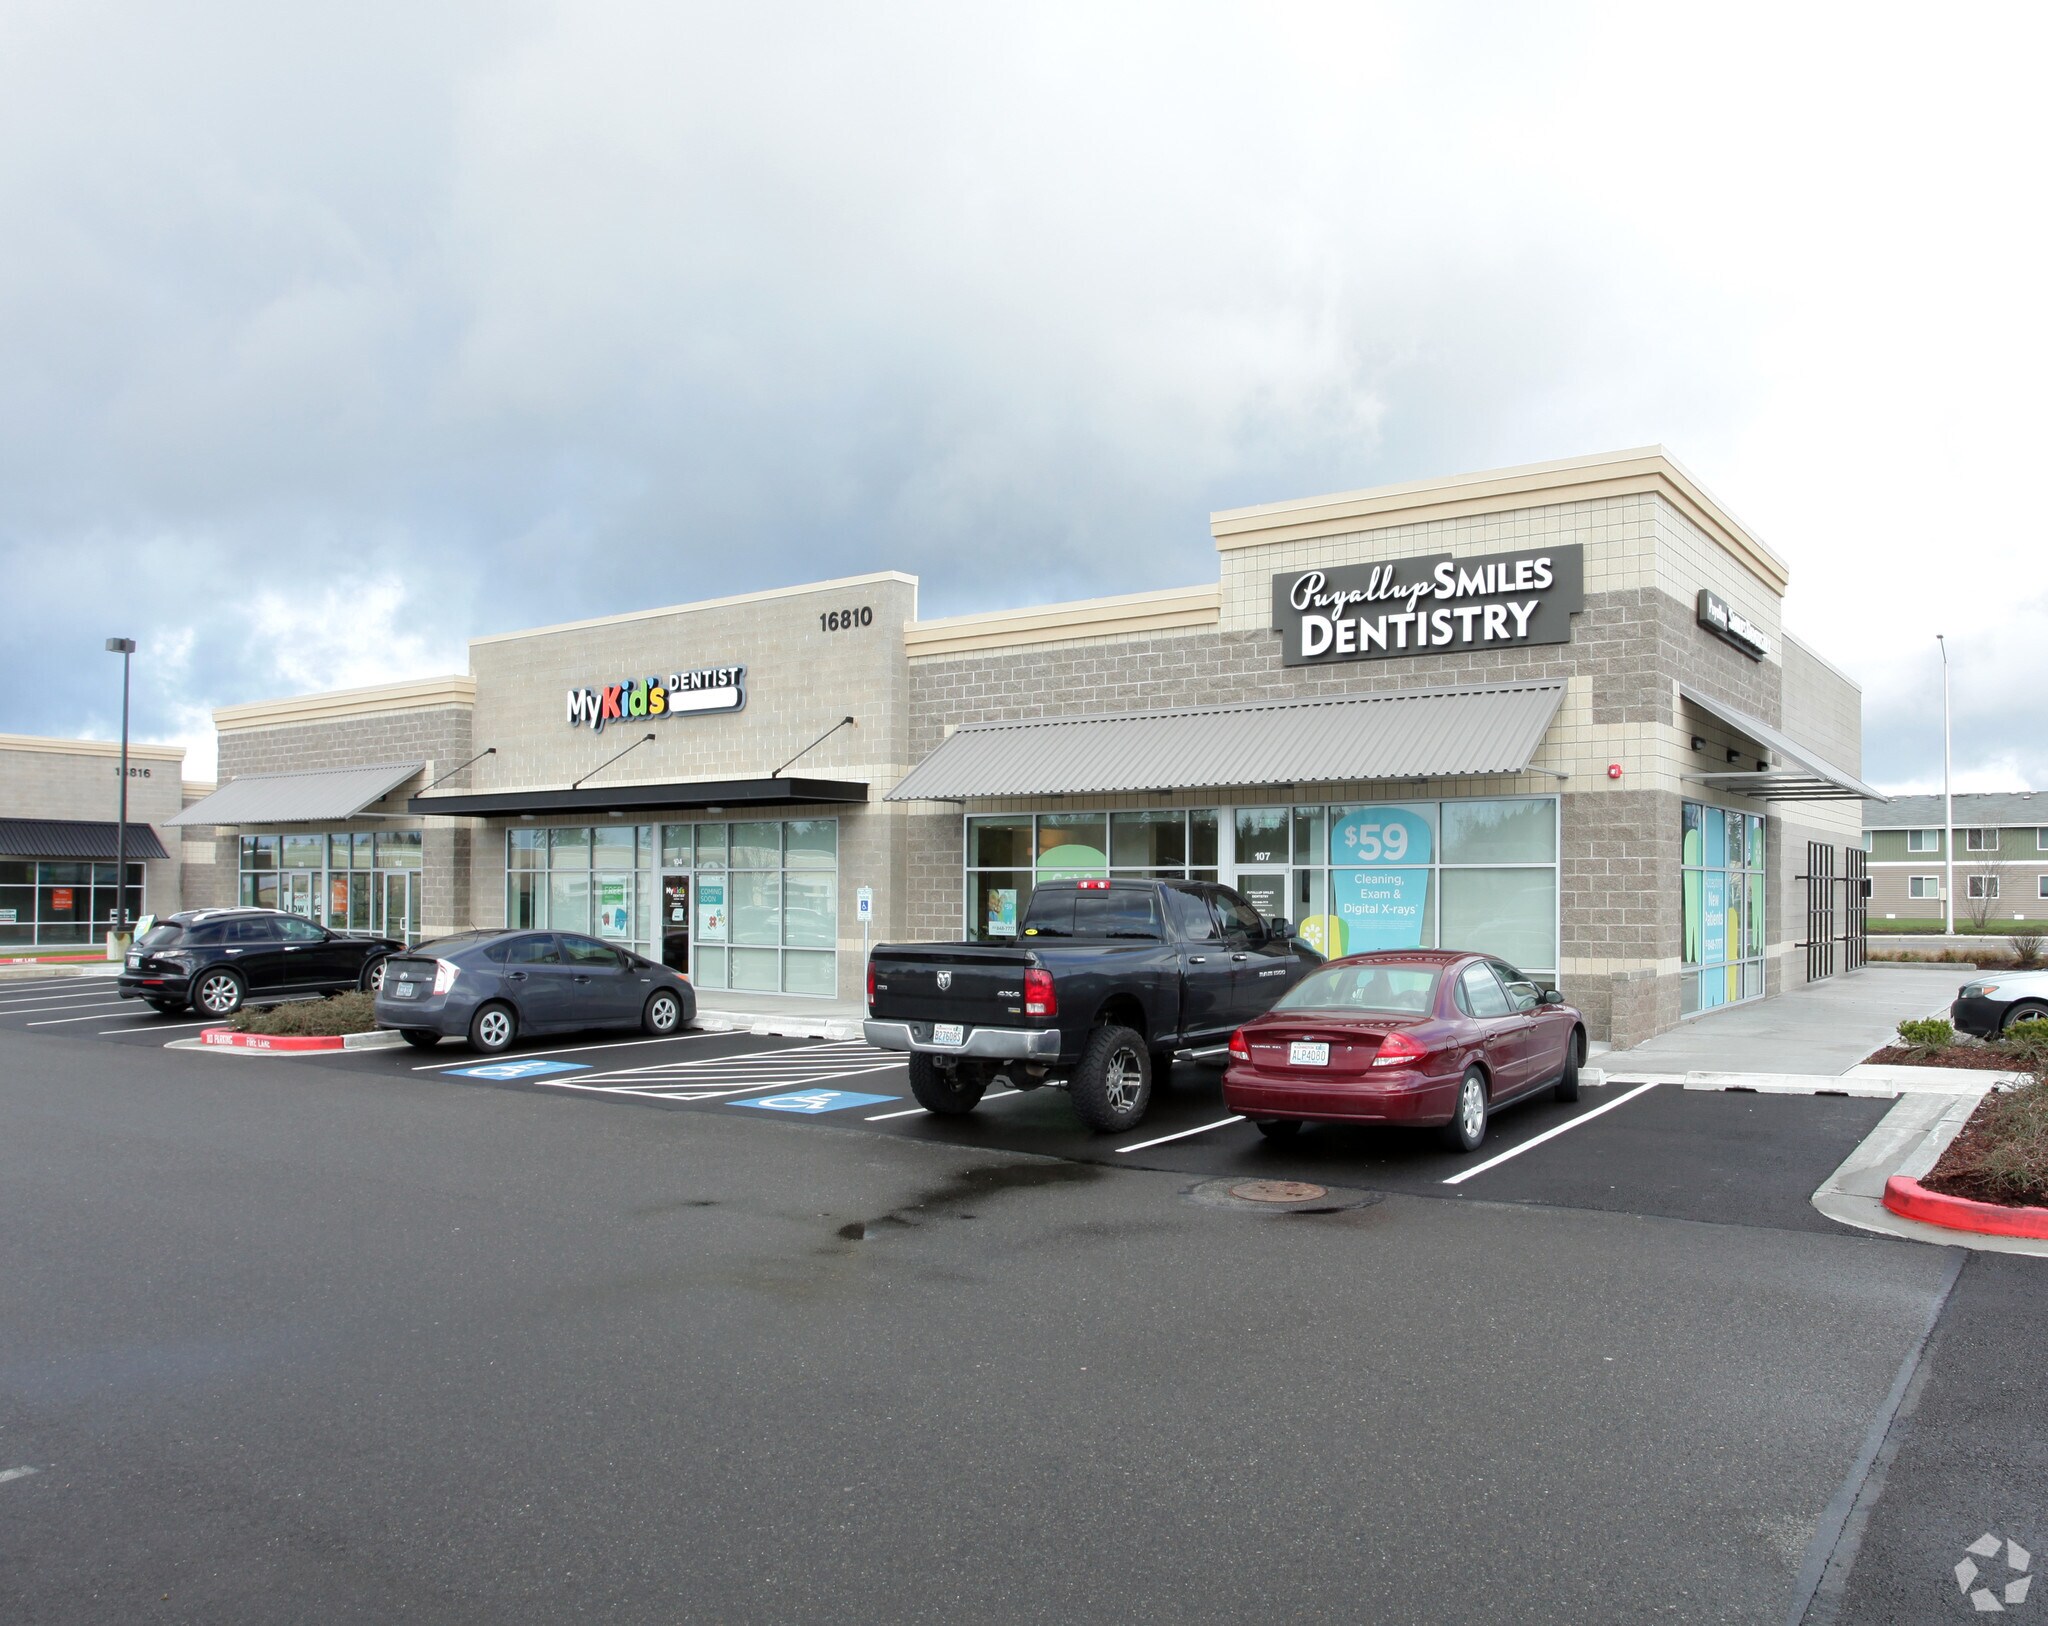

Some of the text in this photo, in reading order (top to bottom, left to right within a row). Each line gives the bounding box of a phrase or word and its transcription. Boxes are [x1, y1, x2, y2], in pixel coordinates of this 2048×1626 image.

[1290, 557, 1553, 621] Puyallup SMILES
[819, 606, 873, 632] 16810
[1301, 600, 1539, 657] DENTISTRY
[669, 667, 738, 691] DENTIST
[115, 767, 151, 777] 1816
[1344, 823, 1408, 861] $59
[1254, 852, 1271, 861] 107
[1354, 873, 1405, 886] Cleaning,
[700, 888, 722, 896] COMING
[1360, 889, 1401, 899] Exam &
[700, 895, 717, 903] SOON
[1343, 903, 1379, 915] Digital
